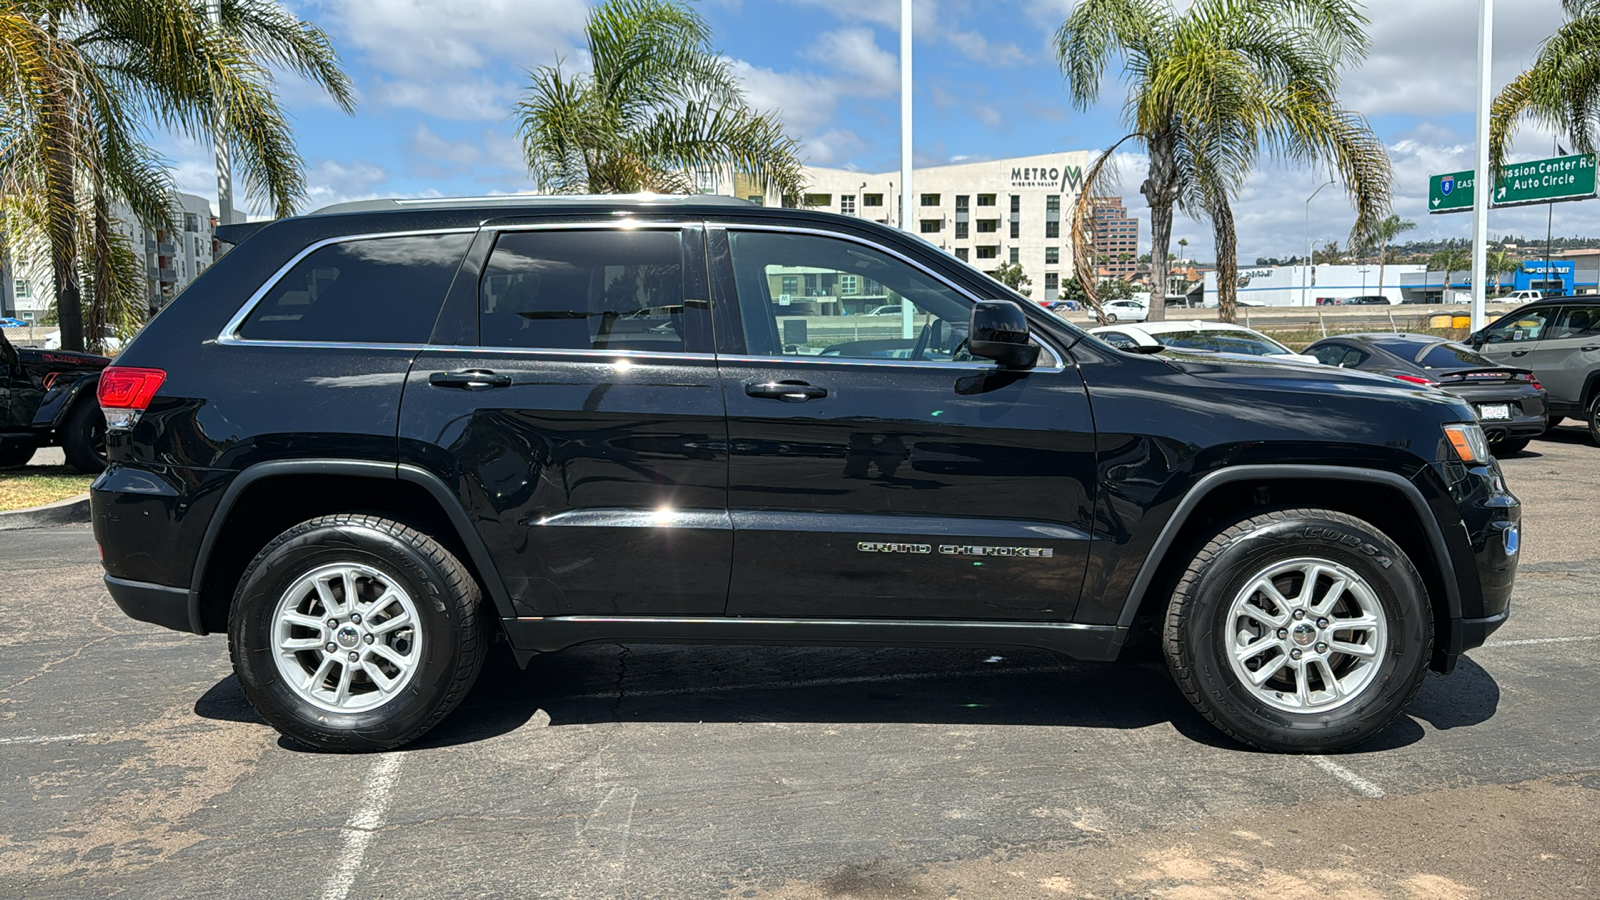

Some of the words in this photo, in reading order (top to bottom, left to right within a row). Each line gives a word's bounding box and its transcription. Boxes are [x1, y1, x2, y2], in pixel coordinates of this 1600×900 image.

[1011, 167, 1059, 181] METRO
[1502, 165, 1536, 178] ission
[1539, 160, 1576, 174] Center
[1579, 156, 1595, 169] Rd
[1444, 181, 1450, 192] 8
[1513, 178, 1540, 191] Auto
[1542, 173, 1575, 187] Circle
[857, 541, 932, 554] GRAND
[938, 544, 1054, 557] CHEROKEE
[1303, 526, 1393, 570] CORSA
